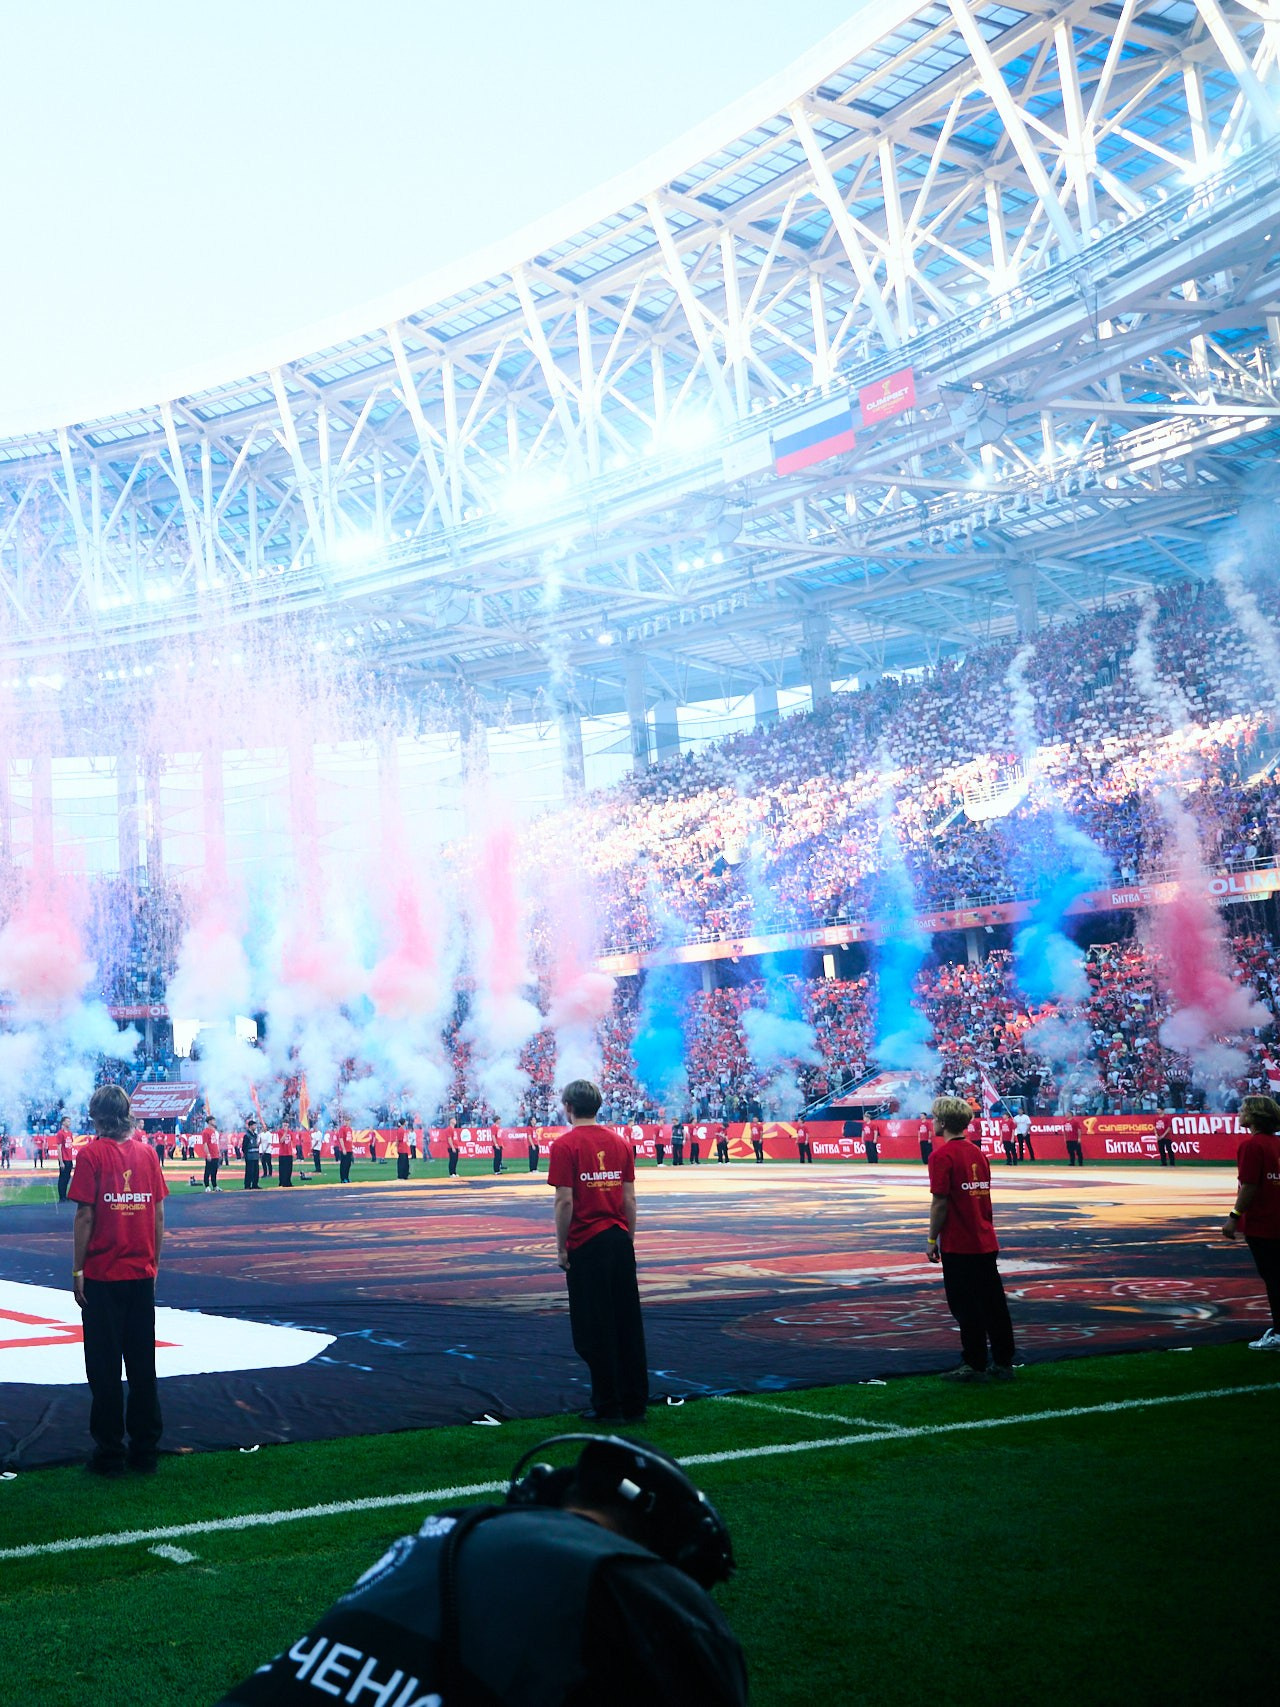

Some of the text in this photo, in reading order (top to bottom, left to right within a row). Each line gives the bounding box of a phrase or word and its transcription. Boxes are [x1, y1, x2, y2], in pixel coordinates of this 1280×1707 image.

[1208, 872, 1280, 895] OLIM
[770, 926, 860, 948] IMPBET
[1030, 1124, 1065, 1132] OLIMP
[1098, 1123, 1155, 1131] СУПЕРКУБО
[853, 1141, 882, 1154] ВОЕ
[1164, 1141, 1200, 1153] ОЛГЕ
[103, 1192, 152, 1203] OLMPBET
[255, 1635, 442, 1707] ЧЕНИ
